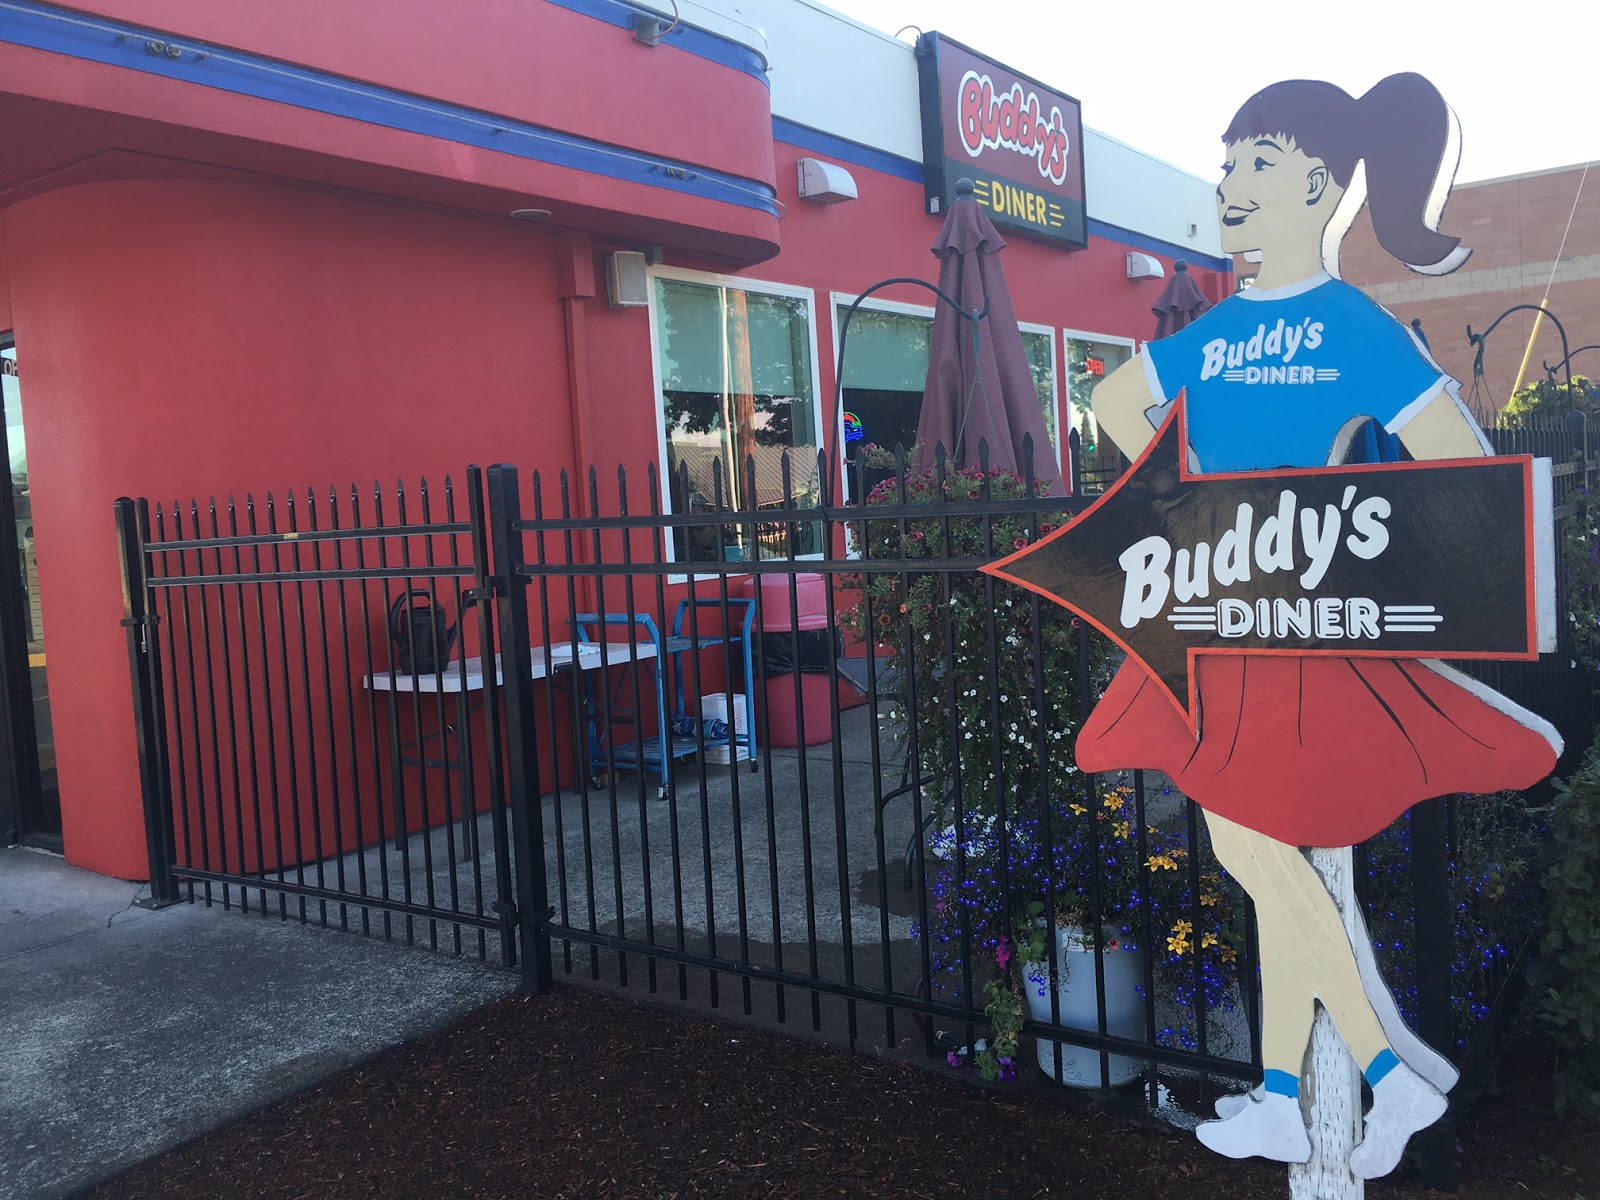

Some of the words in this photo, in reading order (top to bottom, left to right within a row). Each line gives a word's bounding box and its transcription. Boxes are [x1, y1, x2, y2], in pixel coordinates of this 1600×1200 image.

[958, 70, 1069, 186] Buddy's
[992, 181, 1047, 226] DINER
[1200, 317, 1324, 381] Buddy's
[1244, 365, 1315, 385] DINER
[1118, 485, 1392, 629] Buddy's
[1216, 597, 1381, 640] DINER
